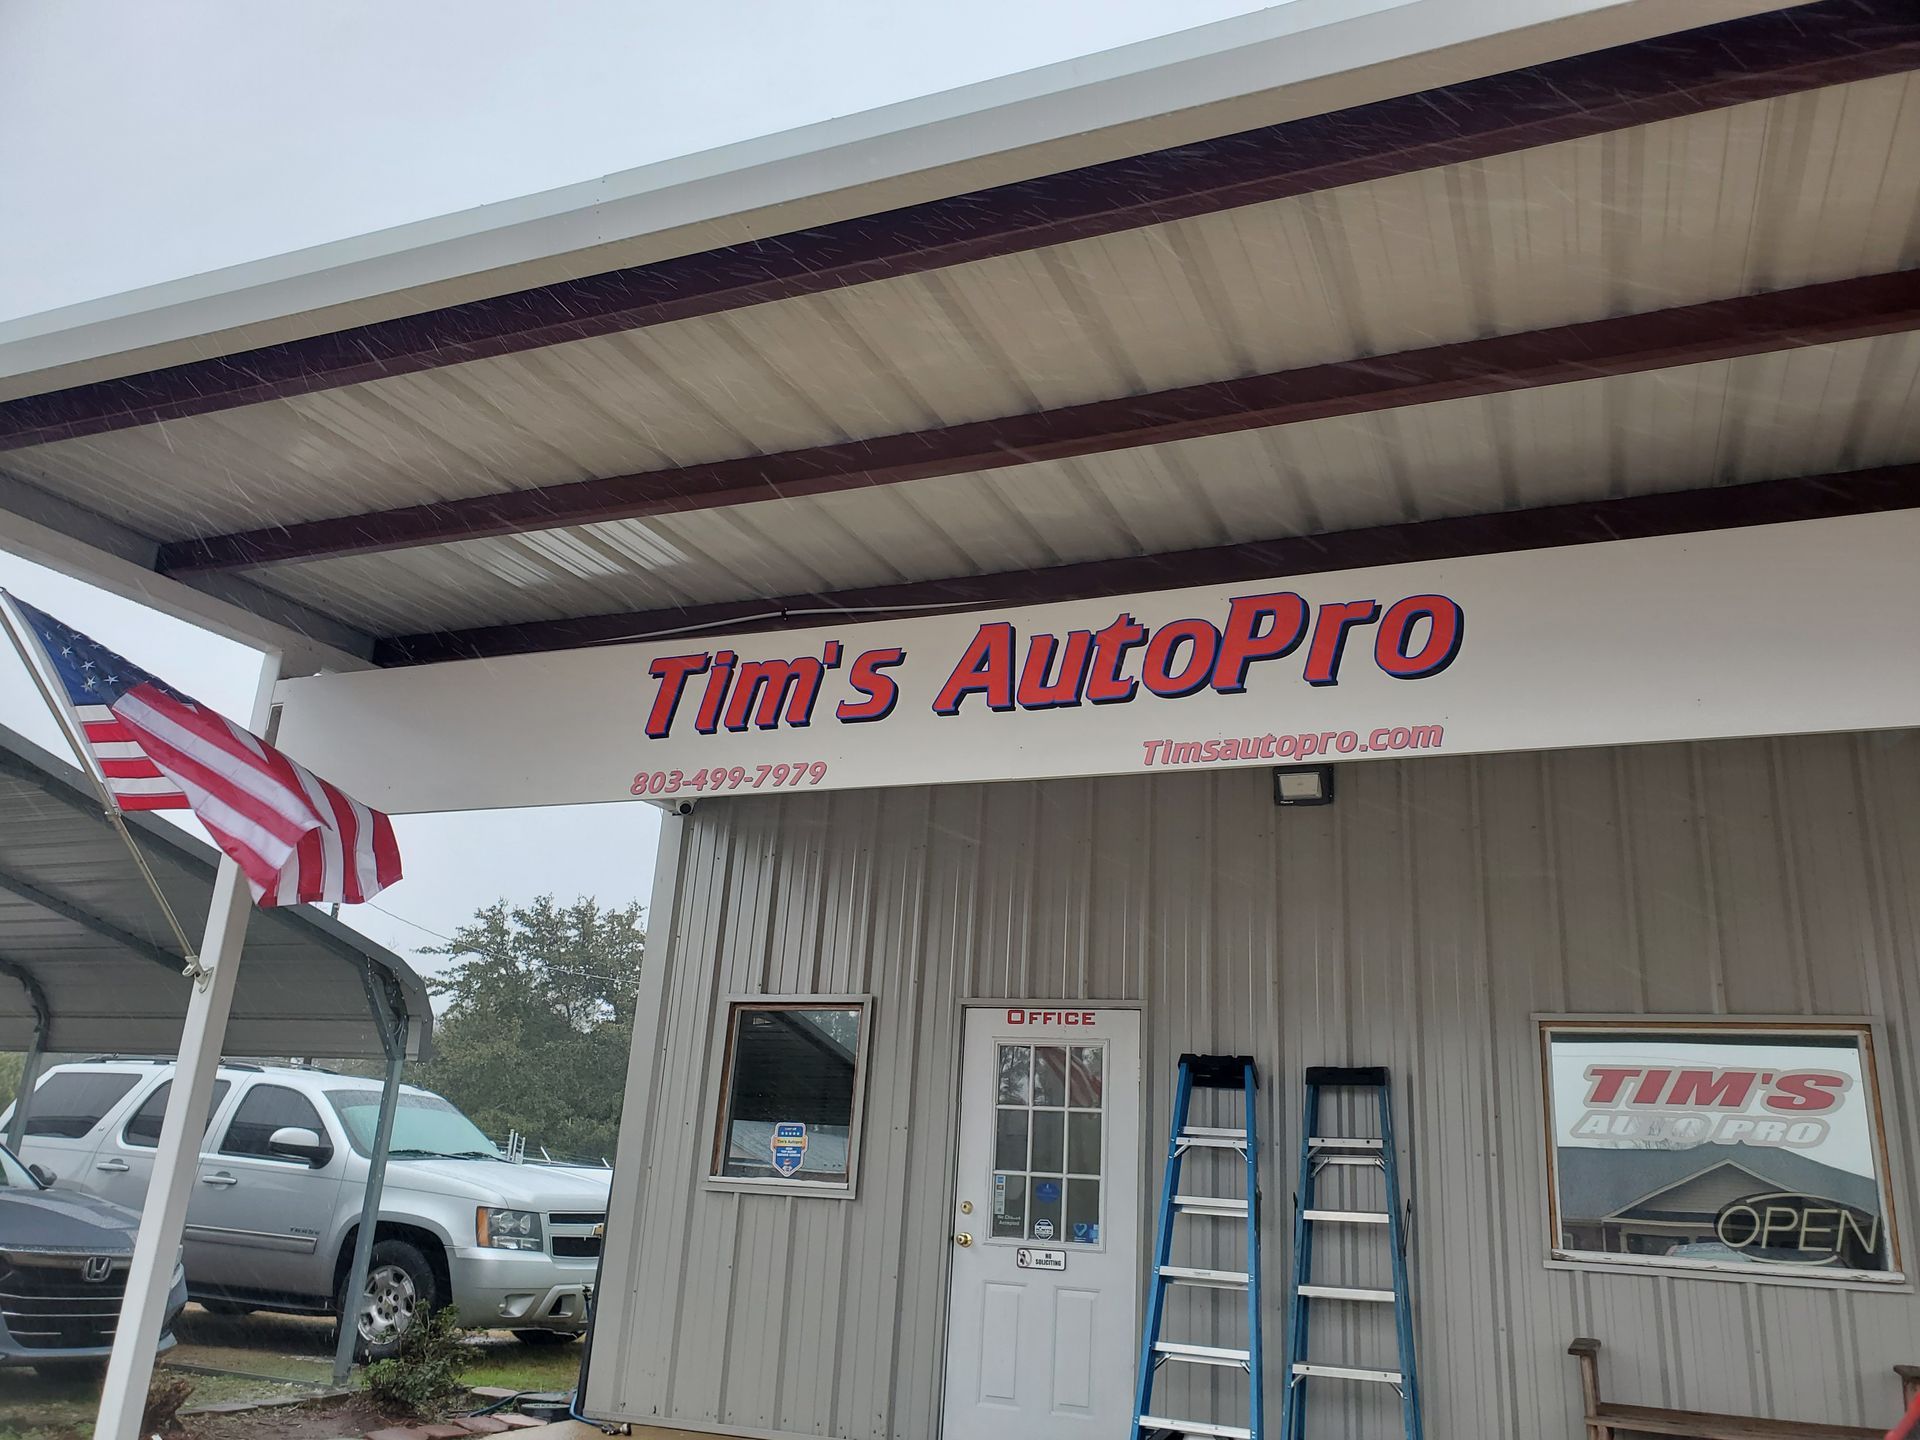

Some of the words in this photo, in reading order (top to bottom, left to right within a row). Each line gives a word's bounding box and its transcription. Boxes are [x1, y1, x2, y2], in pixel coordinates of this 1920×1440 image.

[645, 640, 907, 740] Tim's
[931, 591, 1464, 717] AutoPro
[1142, 724, 1444, 767] Timsautopro.com
[630, 761, 828, 796] 803-499-7979
[1588, 1067, 1846, 1112] TIM'S
[1717, 1118, 1822, 1145] PRO
[1717, 1205, 1880, 1254] OPEN
[1035, 1258, 1062, 1266] SOLICITING
